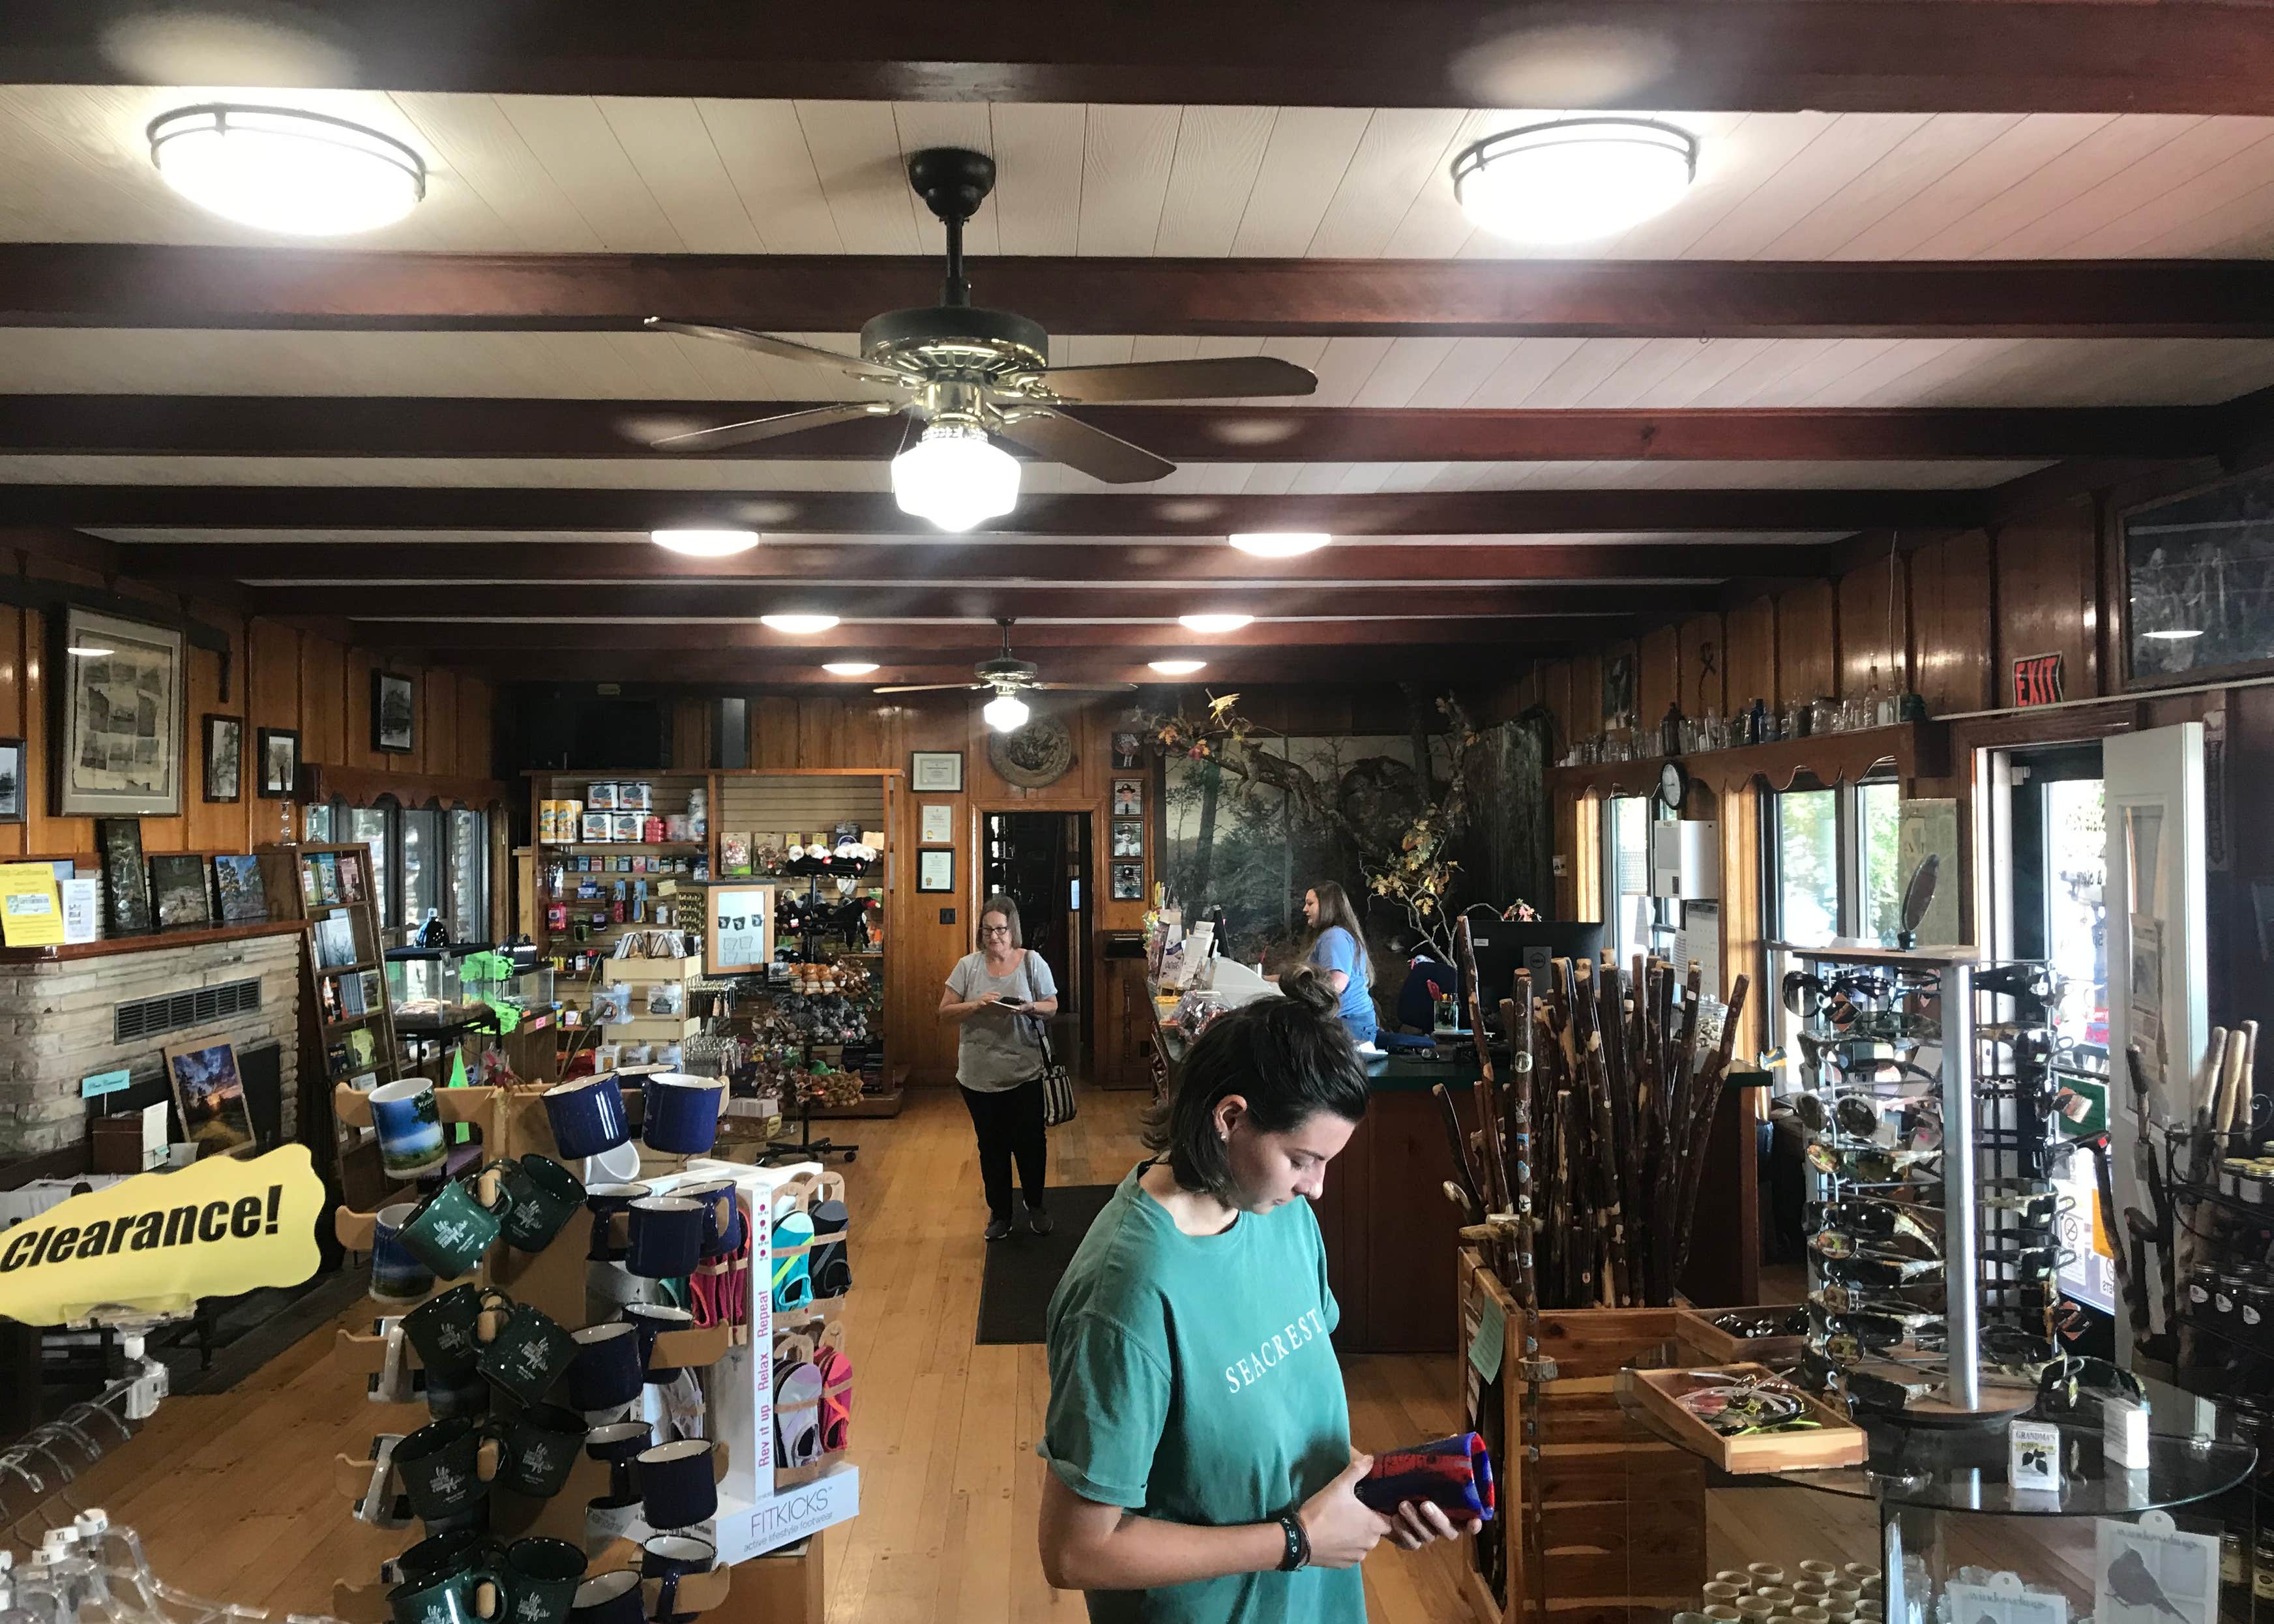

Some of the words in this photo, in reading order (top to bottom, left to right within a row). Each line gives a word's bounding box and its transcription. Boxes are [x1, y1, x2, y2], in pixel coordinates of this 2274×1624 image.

[2016, 657, 2058, 706] EXIT
[0, 1184, 283, 1273] Clearance!
[758, 1290, 771, 1338] Repeat
[1226, 1308, 1323, 1393] SEACREST
[759, 1441, 771, 1467] Rev
[760, 1426, 770, 1439] it
[743, 1537, 767, 1552] active
[769, 1524, 799, 1543] lifestyle
[800, 1511, 833, 1530] footwear
[751, 1488, 829, 1538] FITKICKS
